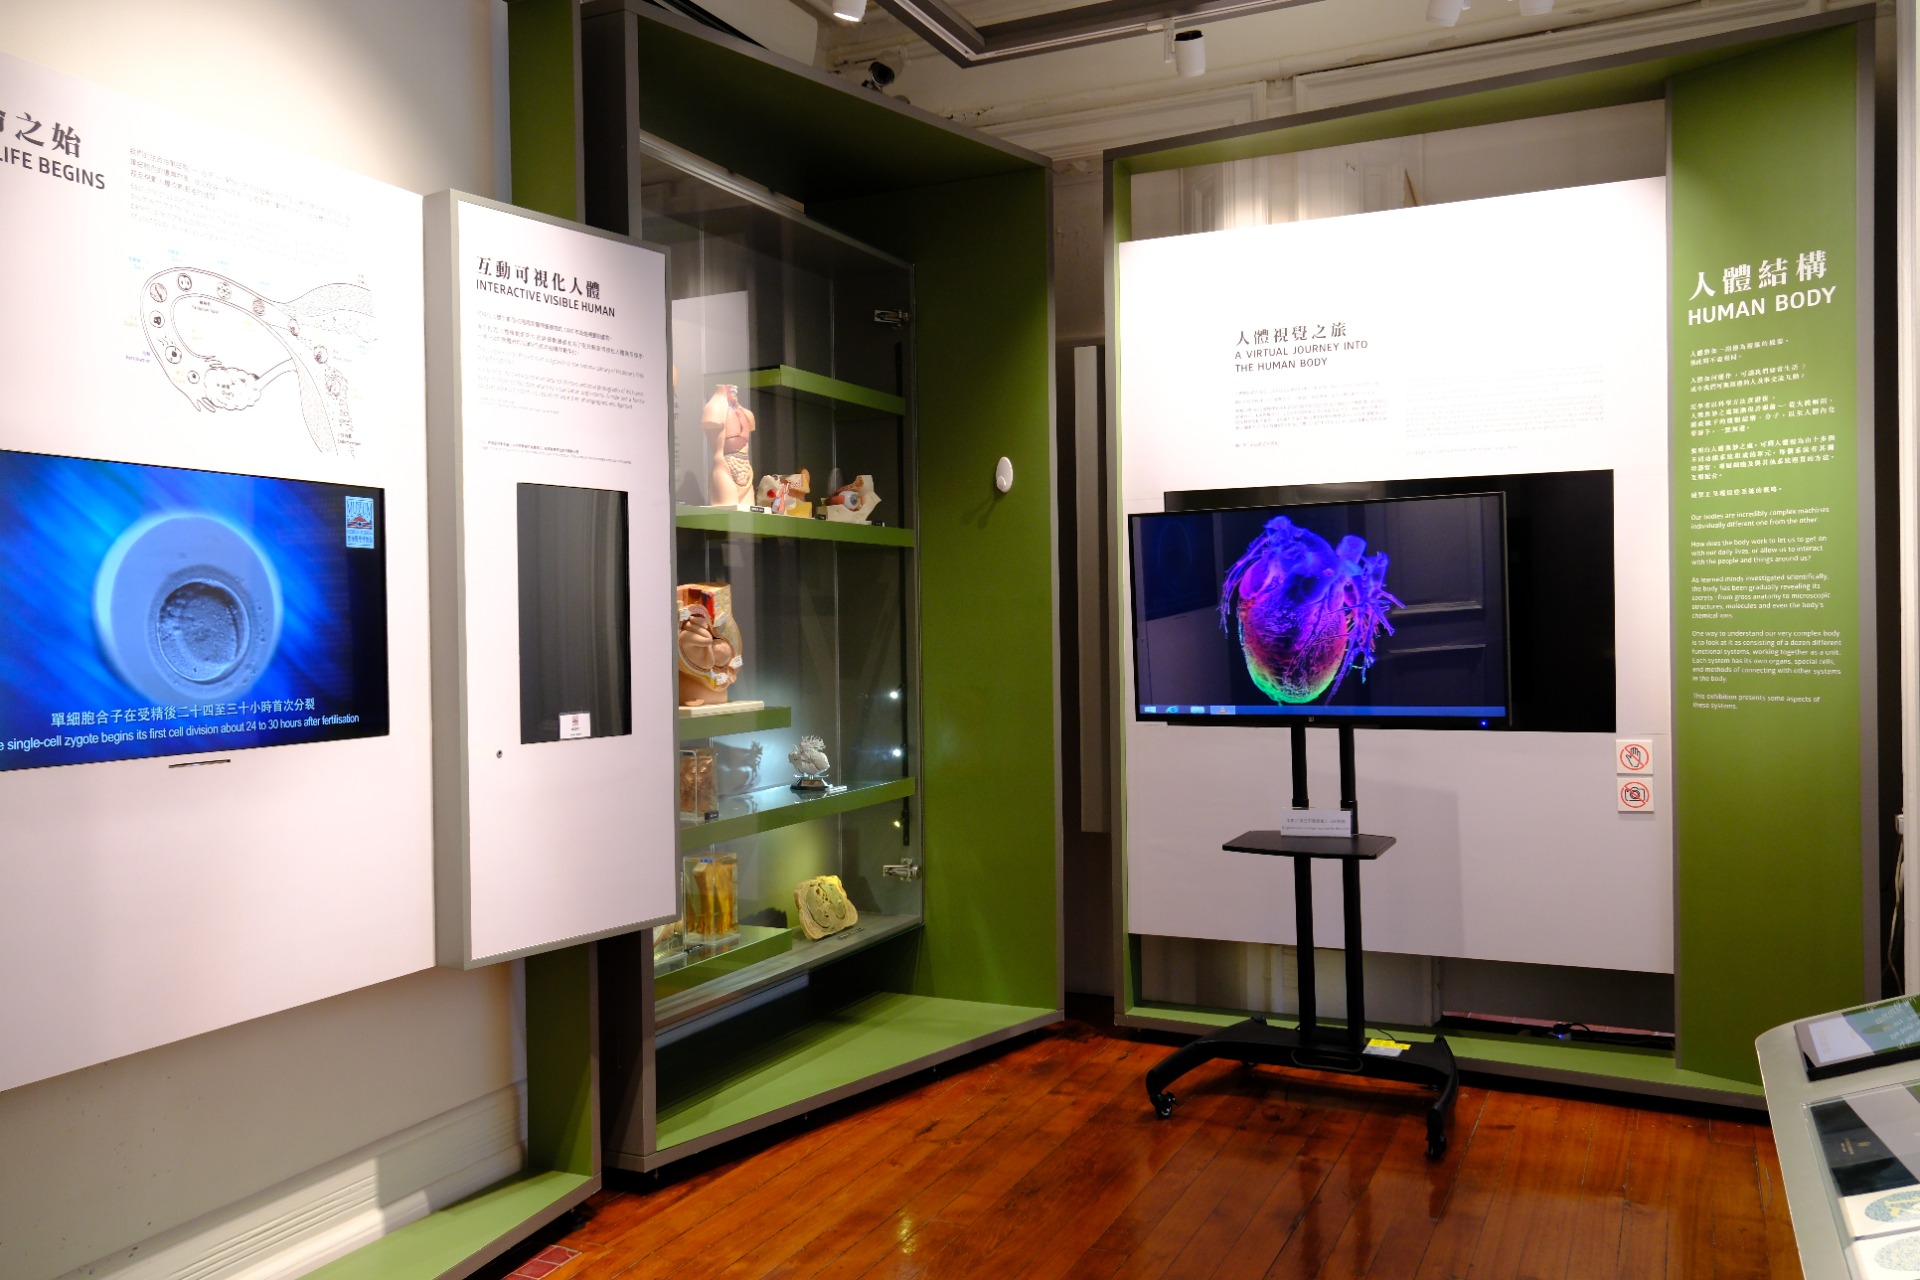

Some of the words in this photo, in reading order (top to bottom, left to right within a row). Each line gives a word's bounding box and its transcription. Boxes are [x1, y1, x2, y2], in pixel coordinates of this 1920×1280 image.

[0, 146, 33, 170] IFE
[39, 156, 105, 190] BEGINS
[477, 256, 600, 299] 互動可視化人體
[1688, 249, 1827, 301] 人體結構
[477, 279, 541, 302] INTERACTIVE
[543, 292, 579, 310] VISIBLE
[581, 301, 615, 318] HUMAN
[1688, 297, 1765, 326] HUMAN
[1775, 285, 1837, 312] BODY
[1236, 322, 1347, 346] 人體視覺之旅
[1235, 351, 1242, 360] A
[1246, 347, 1288, 359] VIRTUAL
[1293, 342, 1339, 355] JOURNEY
[1343, 340, 1368, 350] INTO
[1235, 363, 1254, 373] THE
[1257, 360, 1296, 371] HUMAN
[1300, 357, 1328, 368] BODY
[1737, 510, 1767, 518] incredibly
[1769, 508, 1796, 517] complex
[1798, 506, 1829, 514] machines
[1691, 521, 1725, 530] individually
[1727, 520, 1754, 528] different
[1769, 518, 1785, 526] from
[1787, 517, 1797, 525] the
[1751, 537, 1767, 545] work
[1805, 536, 1816, 544] get
[1760, 546, 1777, 554] allow
[1718, 557, 1738, 566] people
[1753, 556, 1773, 565] things
[1775, 555, 1798, 563] around
[1746, 574, 1784, 583] investigated
[1703, 585, 1718, 593] body
[1749, 583, 1778, 592] gradually
[1780, 582, 1811, 591] revealing
[1734, 594, 1751, 602] gross
[1753, 593, 1781, 601] anatomy
[1791, 591, 1830, 600] microscopic
[1802, 602, 1824, 610] body's
[1728, 629, 1764, 637] understand
[1794, 630, 1821, 638] complex
[1823, 629, 1840, 638] body
[1744, 640, 1774, 648] consisting
[1753, 648, 1778, 657] working
[1780, 648, 1808, 657] together
[1794, 658, 1817, 666] special
[1742, 667, 1776, 676] connecting
[1794, 667, 1811, 675] other
[1813, 668, 1841, 676] systems
[1706, 693, 1737, 701] exhibition
[1739, 694, 1766, 702] presents
[1787, 696, 1811, 704] aspects
[51, 697, 315, 728] 單細胞合子在受精後二十四至三十小時首次分裂
[7, 735, 62, 752] single-cell
[64, 732, 99, 748] zygote
[101, 730, 134, 745] begins
[136, 729, 148, 740] its
[149, 727, 166, 739] first
[168, 726, 184, 737] cell
[186, 723, 219, 737] division
[221, 722, 245, 734] about
[246, 721, 257, 731] 24
[258, 721, 266, 730] to
[268, 719, 279, 730] 30
[280, 718, 302, 729] hours
[303, 716, 321, 727] after
[321, 713, 359, 726] fertilisation
